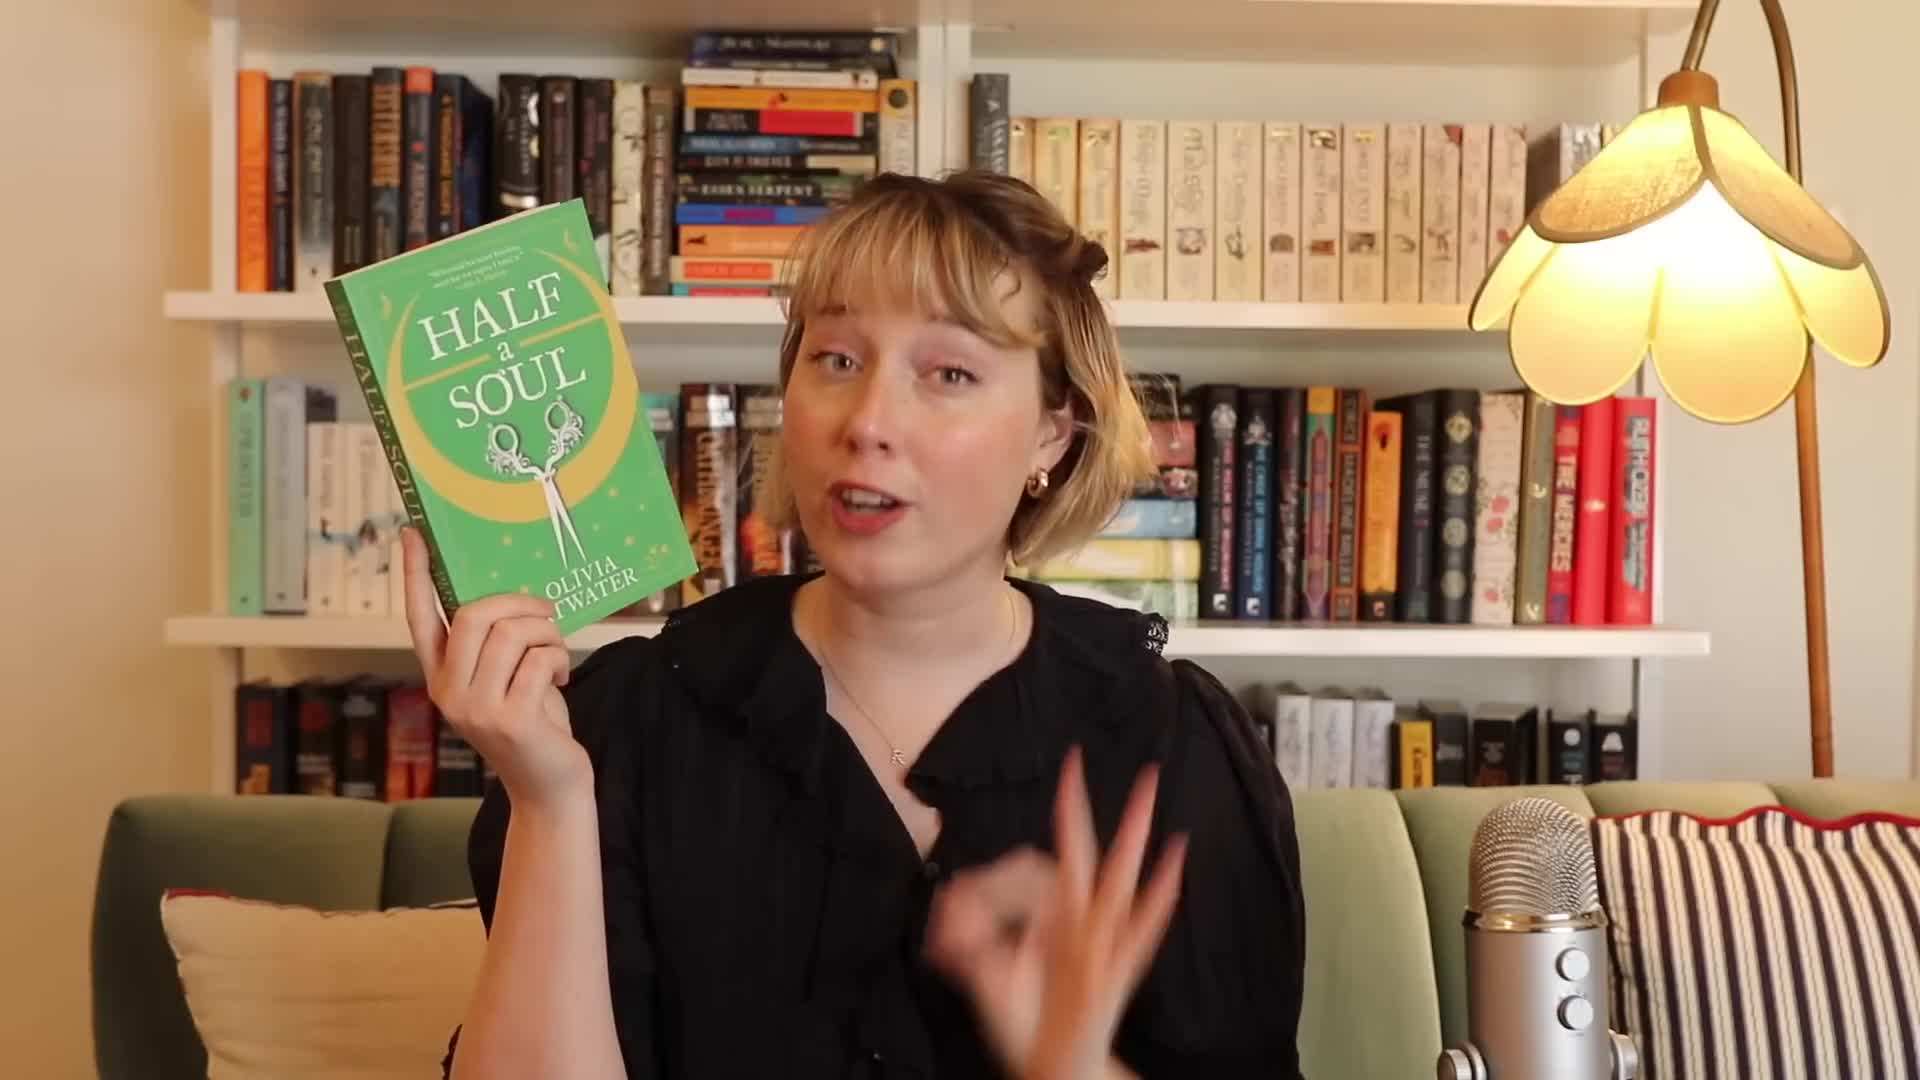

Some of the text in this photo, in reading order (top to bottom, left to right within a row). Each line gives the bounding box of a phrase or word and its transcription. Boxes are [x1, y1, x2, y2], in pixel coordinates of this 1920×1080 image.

[417, 272, 561, 361] HALF
[498, 340, 515, 362] a
[448, 346, 588, 429] SOUL
[1557, 455, 1577, 489] THE
[545, 555, 618, 600] OLIVIA
[548, 567, 640, 622] TWATER
